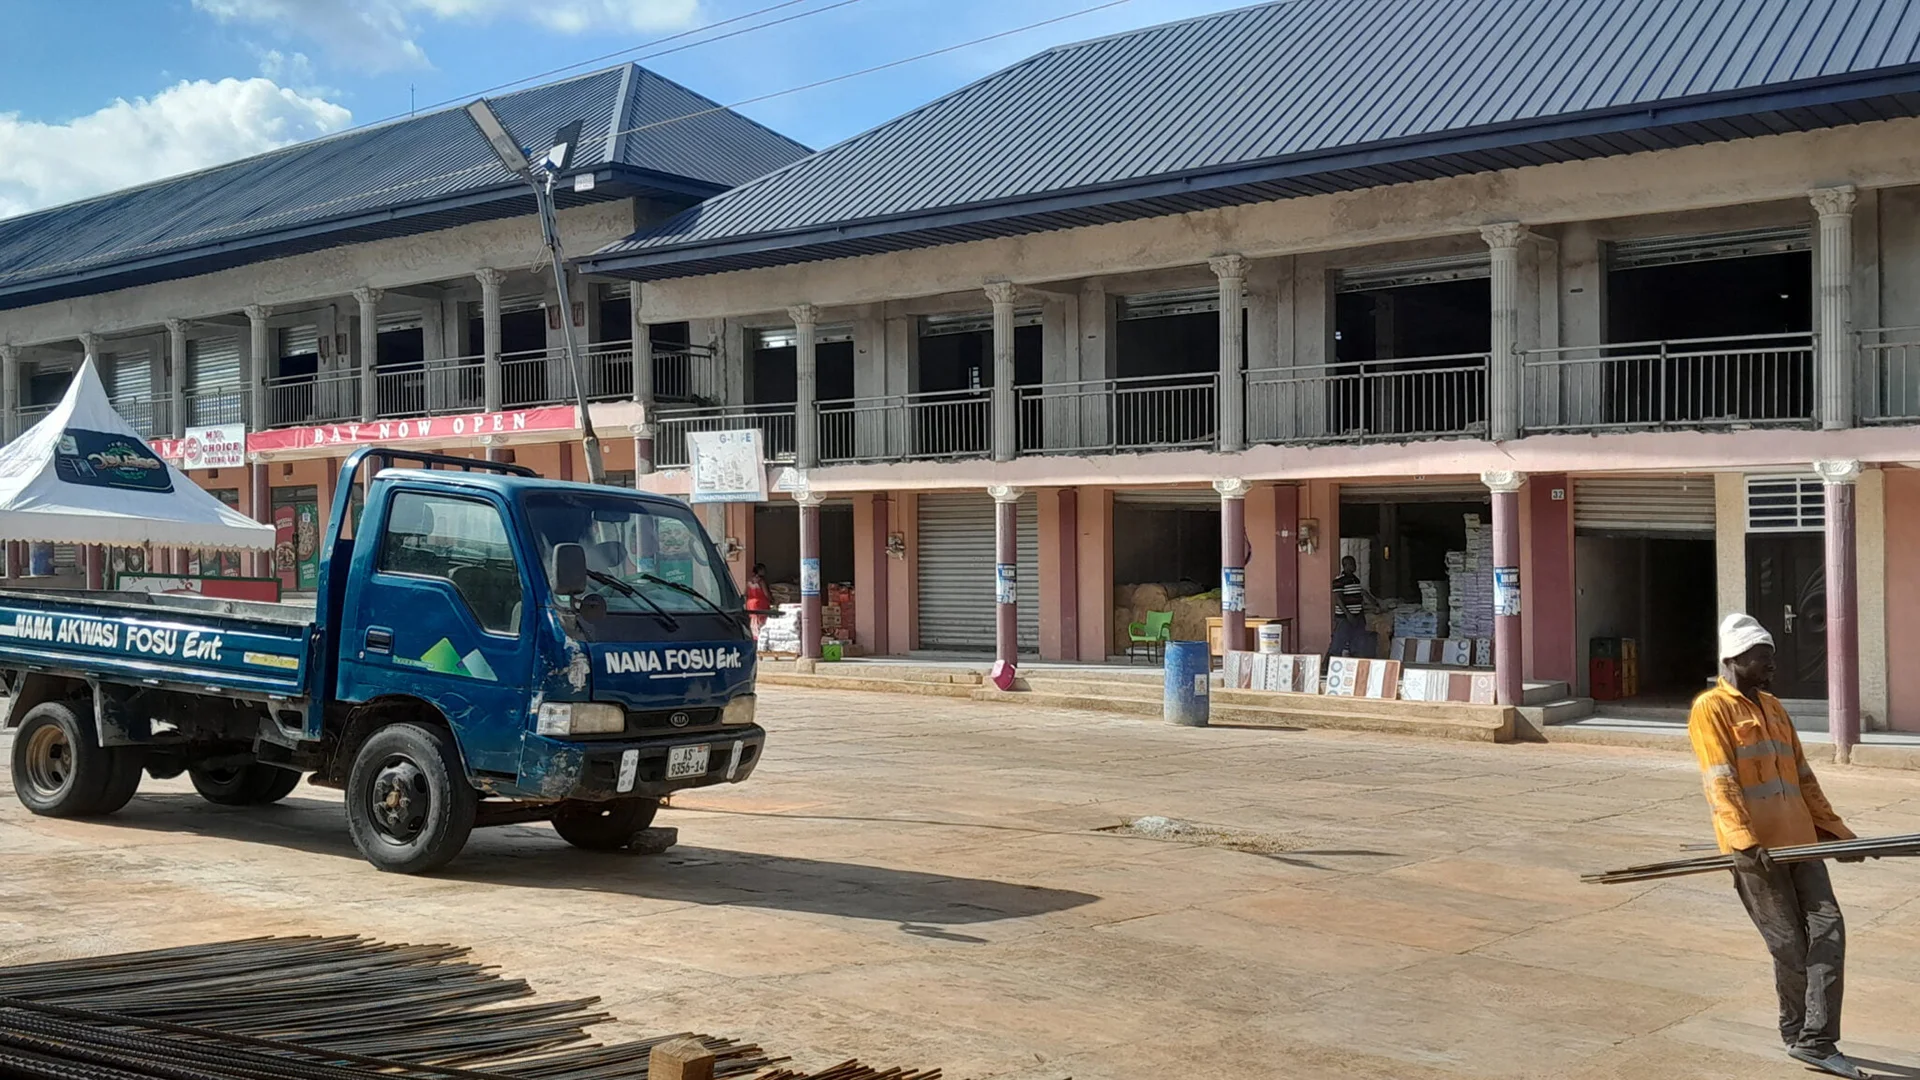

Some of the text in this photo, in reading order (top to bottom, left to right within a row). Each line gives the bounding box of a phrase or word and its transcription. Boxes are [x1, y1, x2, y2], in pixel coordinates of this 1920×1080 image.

[314, 412, 526, 443] BAY NOW OPEN
[202, 442, 239, 453] CHOICE
[1552, 490, 1563, 499] 32
[15, 614, 53, 641] NANA
[56, 618, 119, 648] AKWASI
[125, 627, 178, 656] FOSU
[182, 631, 222, 661] Ent.
[605, 646, 742, 674] NANA FOSU Ent.
[673, 715, 687, 723] KIA
[683, 749, 693, 761] AS
[671, 760, 705, 775] 9356-14
